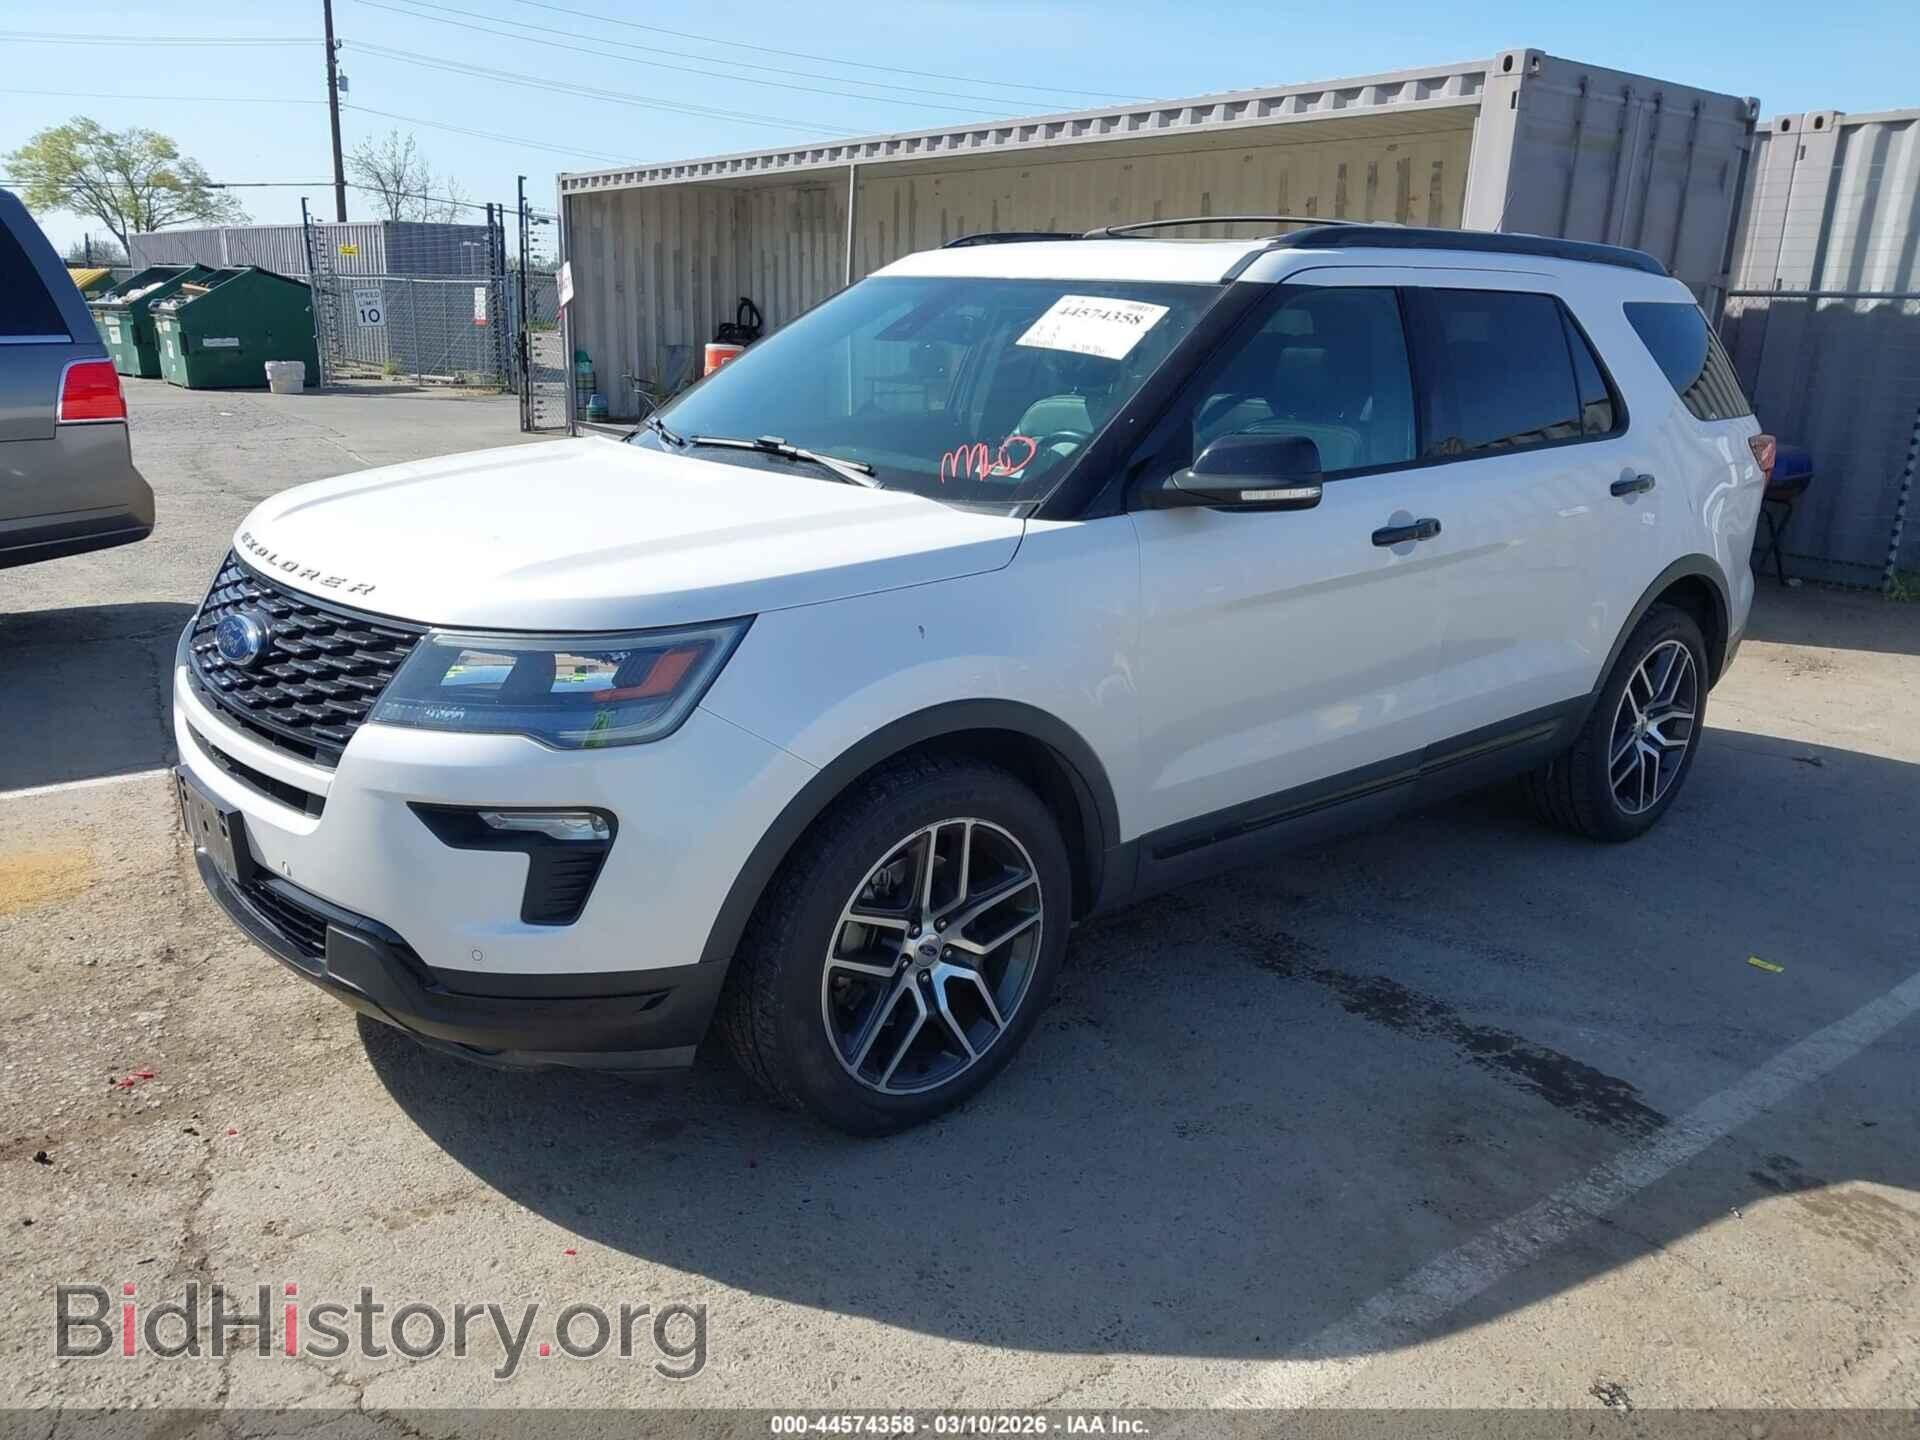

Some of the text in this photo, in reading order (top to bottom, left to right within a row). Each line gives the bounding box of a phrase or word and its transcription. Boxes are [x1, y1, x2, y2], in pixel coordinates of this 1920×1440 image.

[360, 308, 380, 323] 10
[1056, 306, 1145, 325] 44574358
[241, 532, 376, 596] EXPLORER
